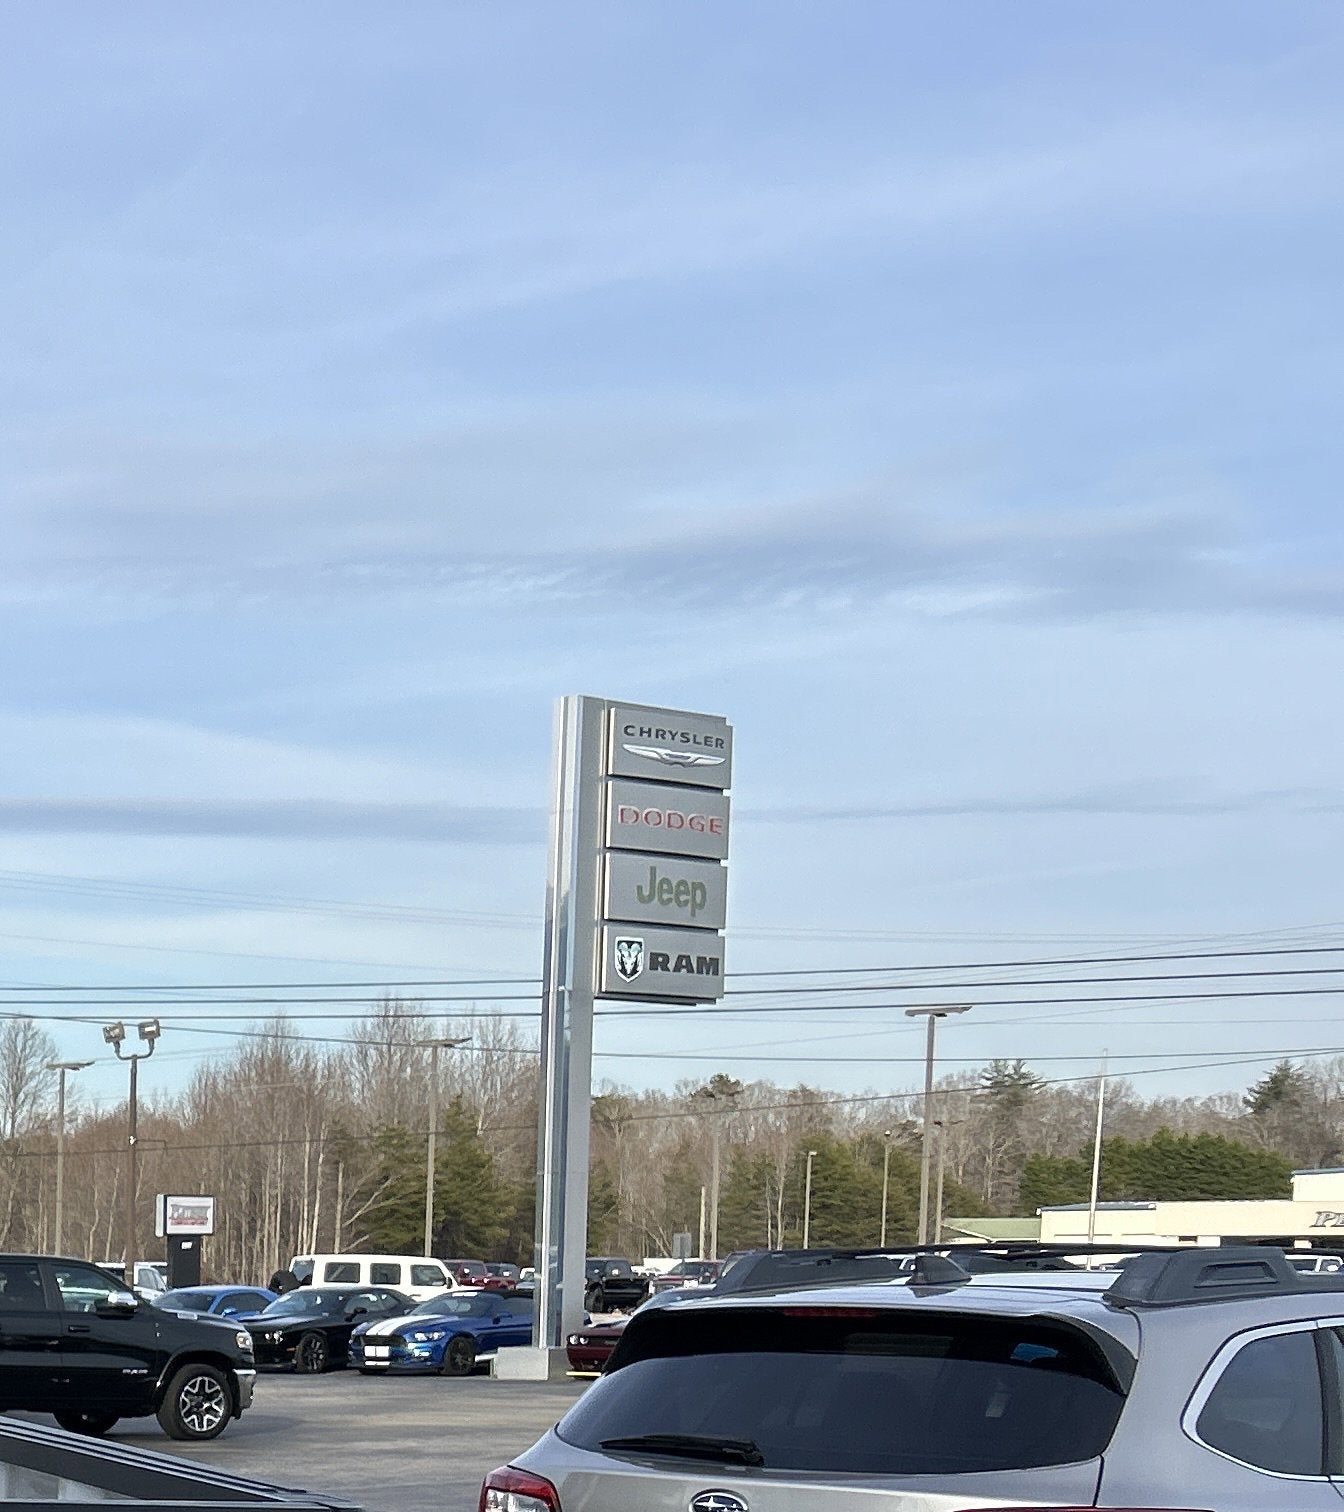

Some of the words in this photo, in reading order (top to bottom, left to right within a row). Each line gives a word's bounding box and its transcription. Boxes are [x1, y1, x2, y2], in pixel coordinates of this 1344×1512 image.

[623, 724, 725, 749] CHRYSLER
[617, 804, 725, 835] DODGE
[636, 865, 708, 917] Jeep
[649, 951, 720, 977] RAM
